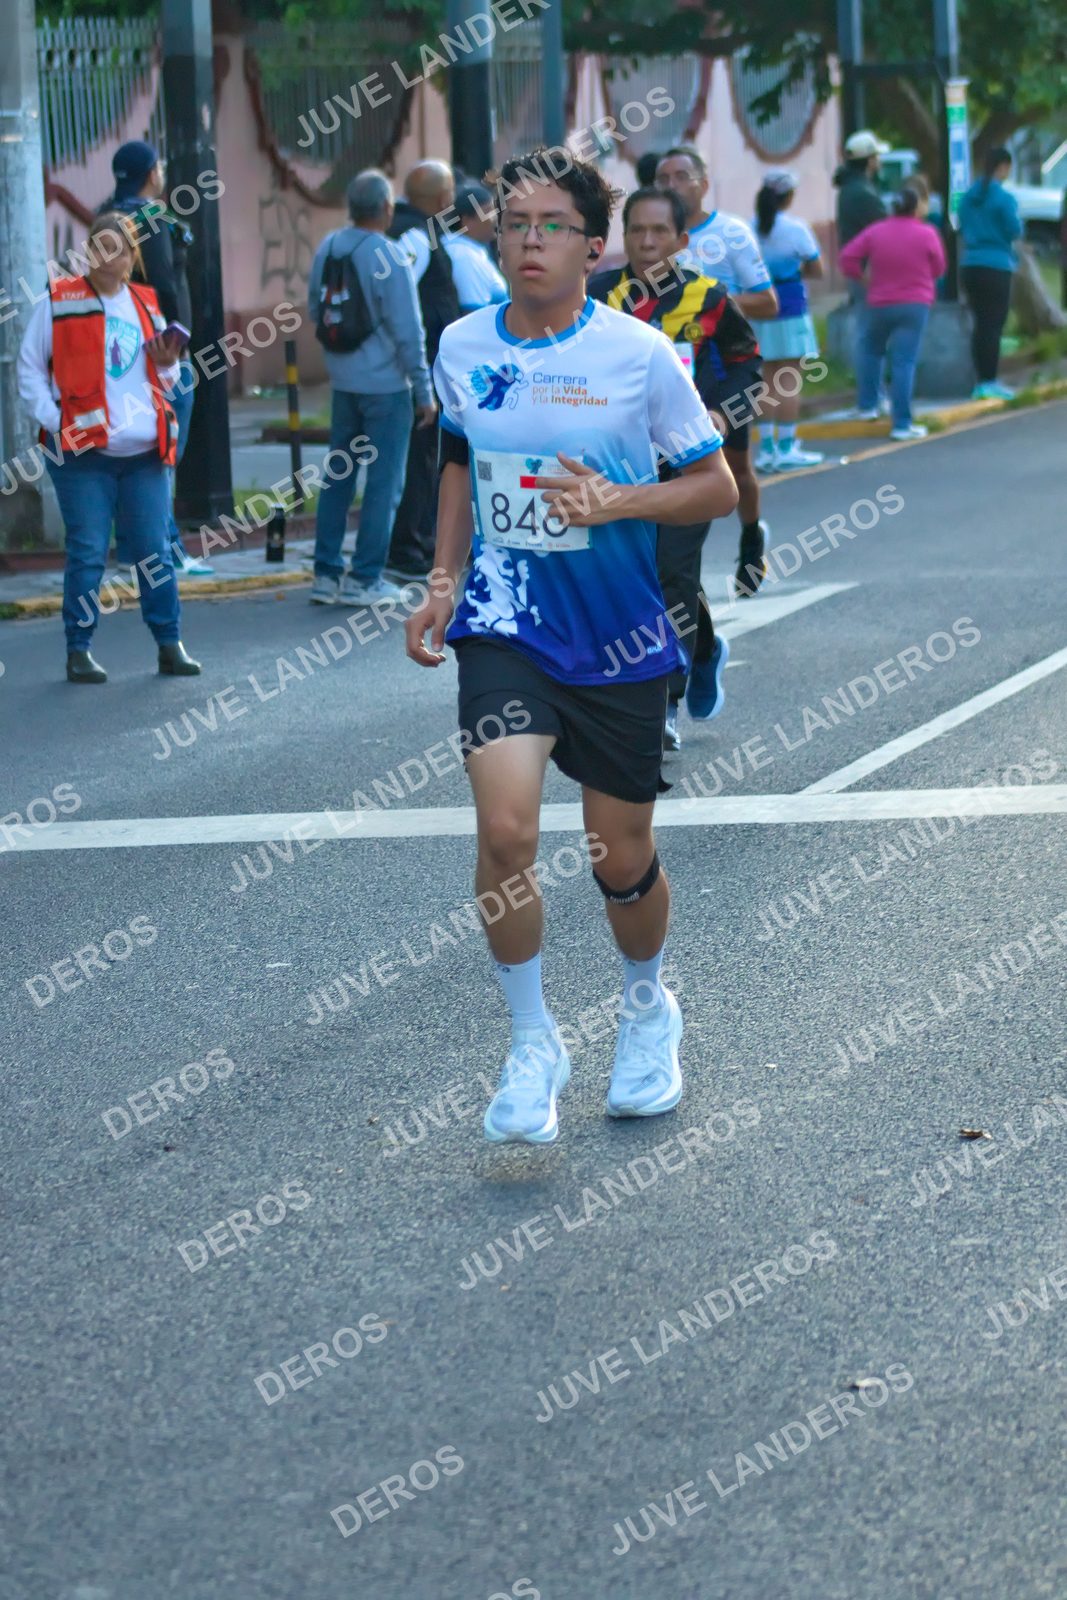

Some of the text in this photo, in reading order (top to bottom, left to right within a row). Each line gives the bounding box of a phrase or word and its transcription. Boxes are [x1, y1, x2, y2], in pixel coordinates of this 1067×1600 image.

[533, 372, 587, 385] Carrera
[532, 385, 588, 396] por la Vida
[551, 395, 608, 407] Integridad
